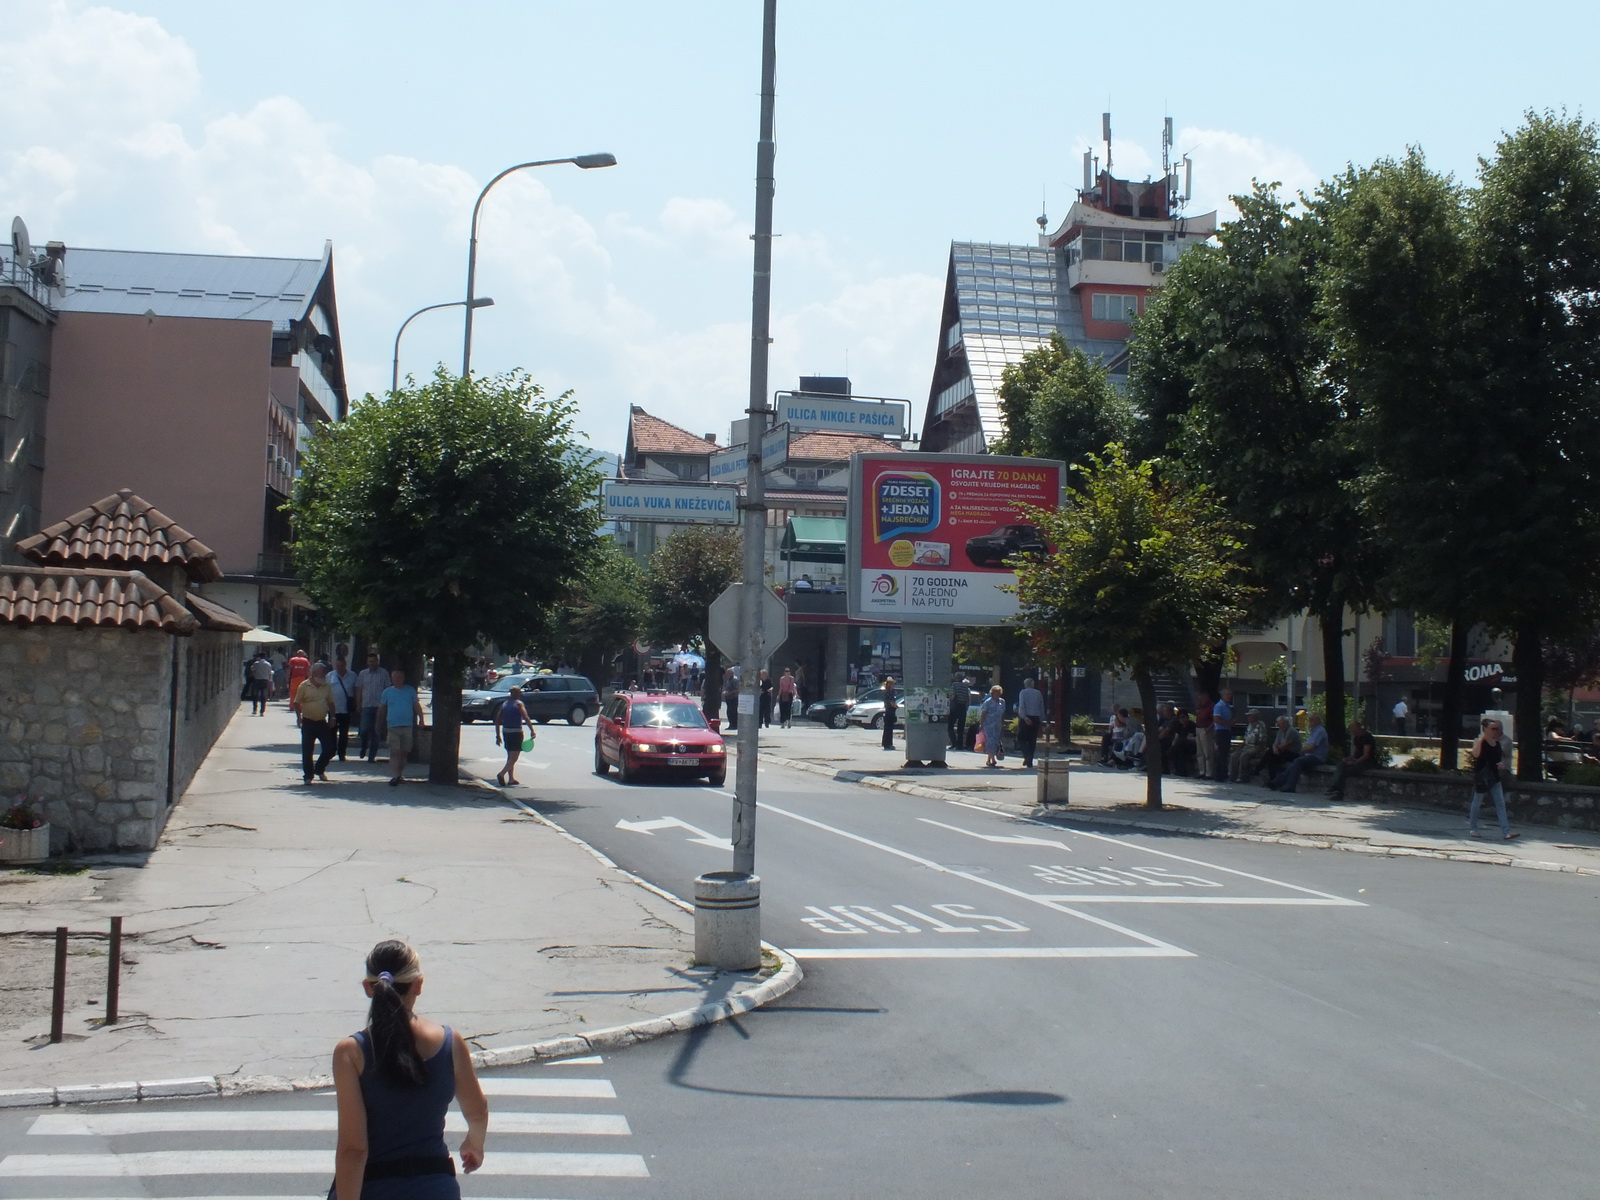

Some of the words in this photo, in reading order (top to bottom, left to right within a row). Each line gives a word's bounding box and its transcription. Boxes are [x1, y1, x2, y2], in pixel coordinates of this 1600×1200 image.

[787, 408, 817, 420] ULICA
[820, 411, 856, 424] NIKOLE
[951, 469, 995, 480] IGRAJTE
[997, 471, 1010, 480] 70
[1012, 472, 1046, 482] DANA!
[882, 485, 931, 497] 7DESET
[609, 495, 640, 508] ULICA
[643, 497, 671, 509] VUKA
[674, 496, 732, 511] KNEŽEVIĆA
[912, 577, 924, 586] 70
[927, 578, 968, 587] GODINA
[912, 587, 957, 597] ZAJEDNO
[912, 597, 926, 606] NA
[928, 598, 954, 607] PUTU
[800, 903, 1031, 934] STOP
